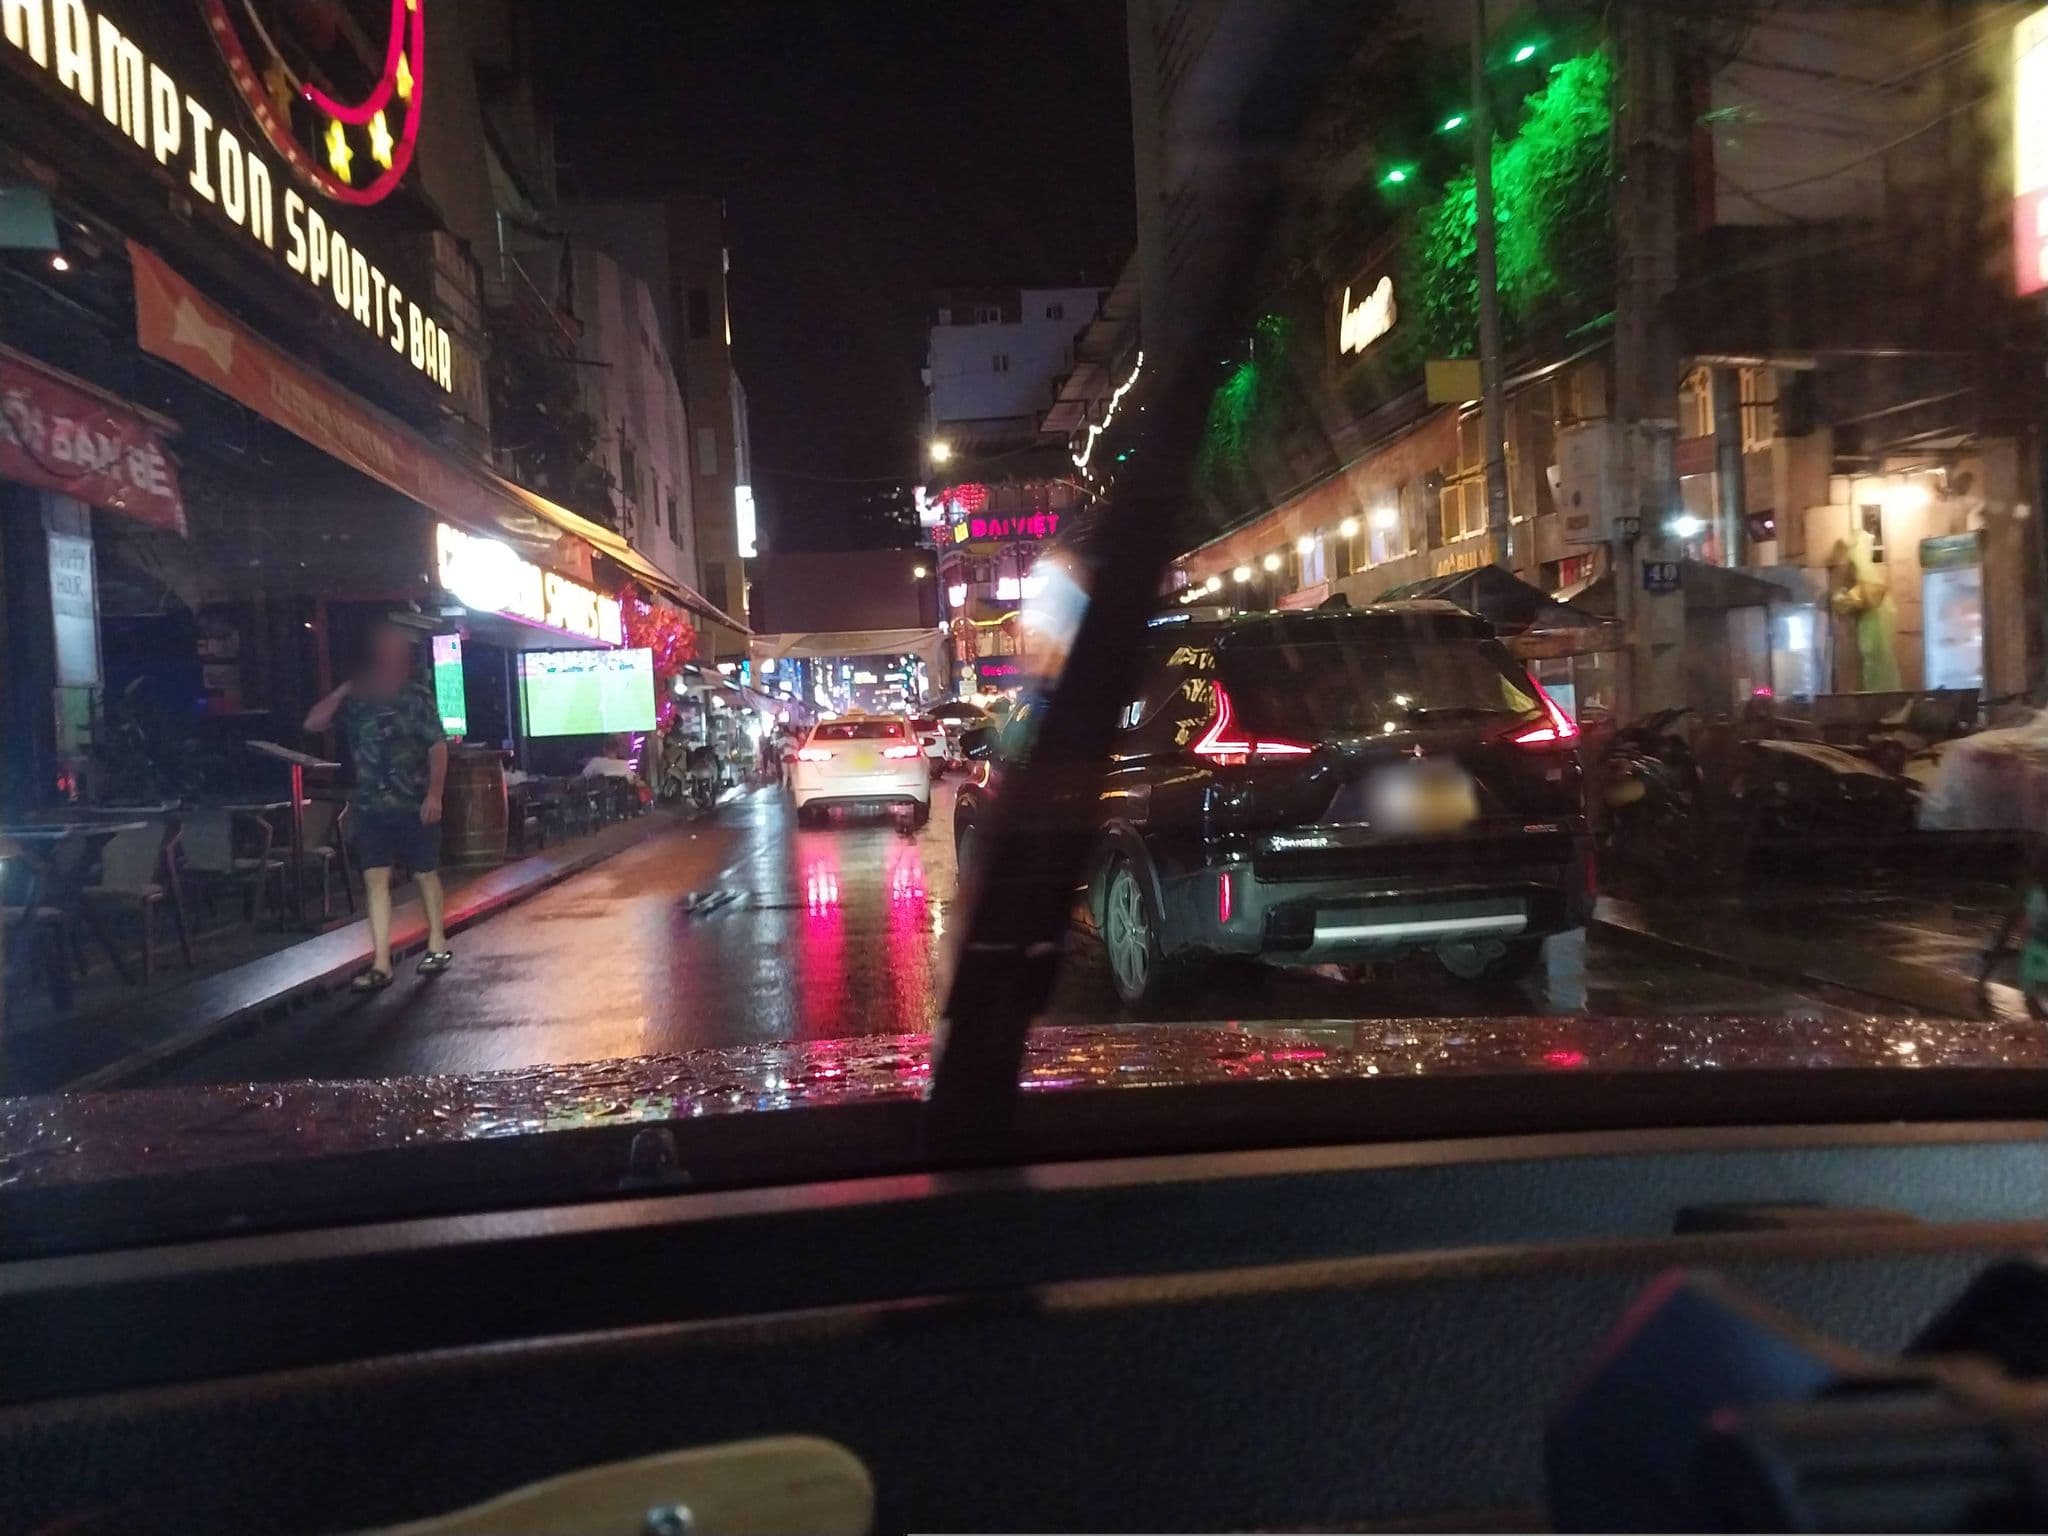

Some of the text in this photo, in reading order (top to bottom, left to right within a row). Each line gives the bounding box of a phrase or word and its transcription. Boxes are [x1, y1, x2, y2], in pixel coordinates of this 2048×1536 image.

[285, 188, 403, 354] SPORTS
[409, 302, 452, 392] BAR
[1648, 563, 1678, 582] 40
